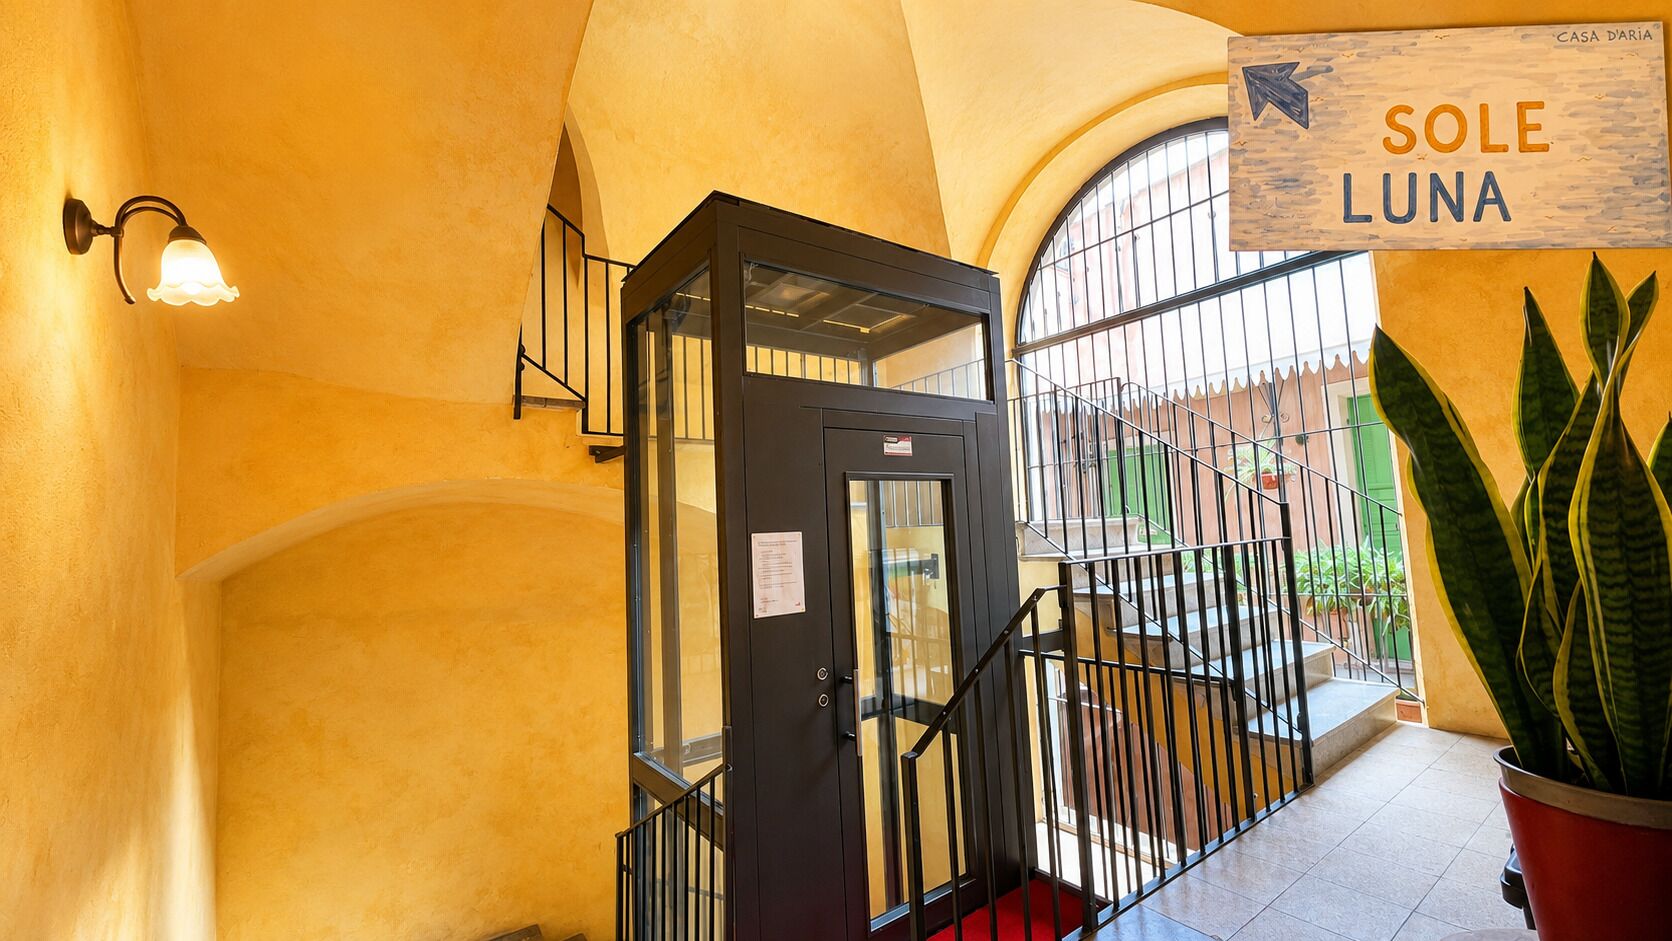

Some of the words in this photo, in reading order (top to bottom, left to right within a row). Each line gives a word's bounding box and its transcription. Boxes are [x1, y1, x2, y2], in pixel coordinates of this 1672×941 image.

[1556, 30, 1600, 43] CASA
[1382, 101, 1550, 155] SOLE
[1343, 171, 1512, 224] LUNA
